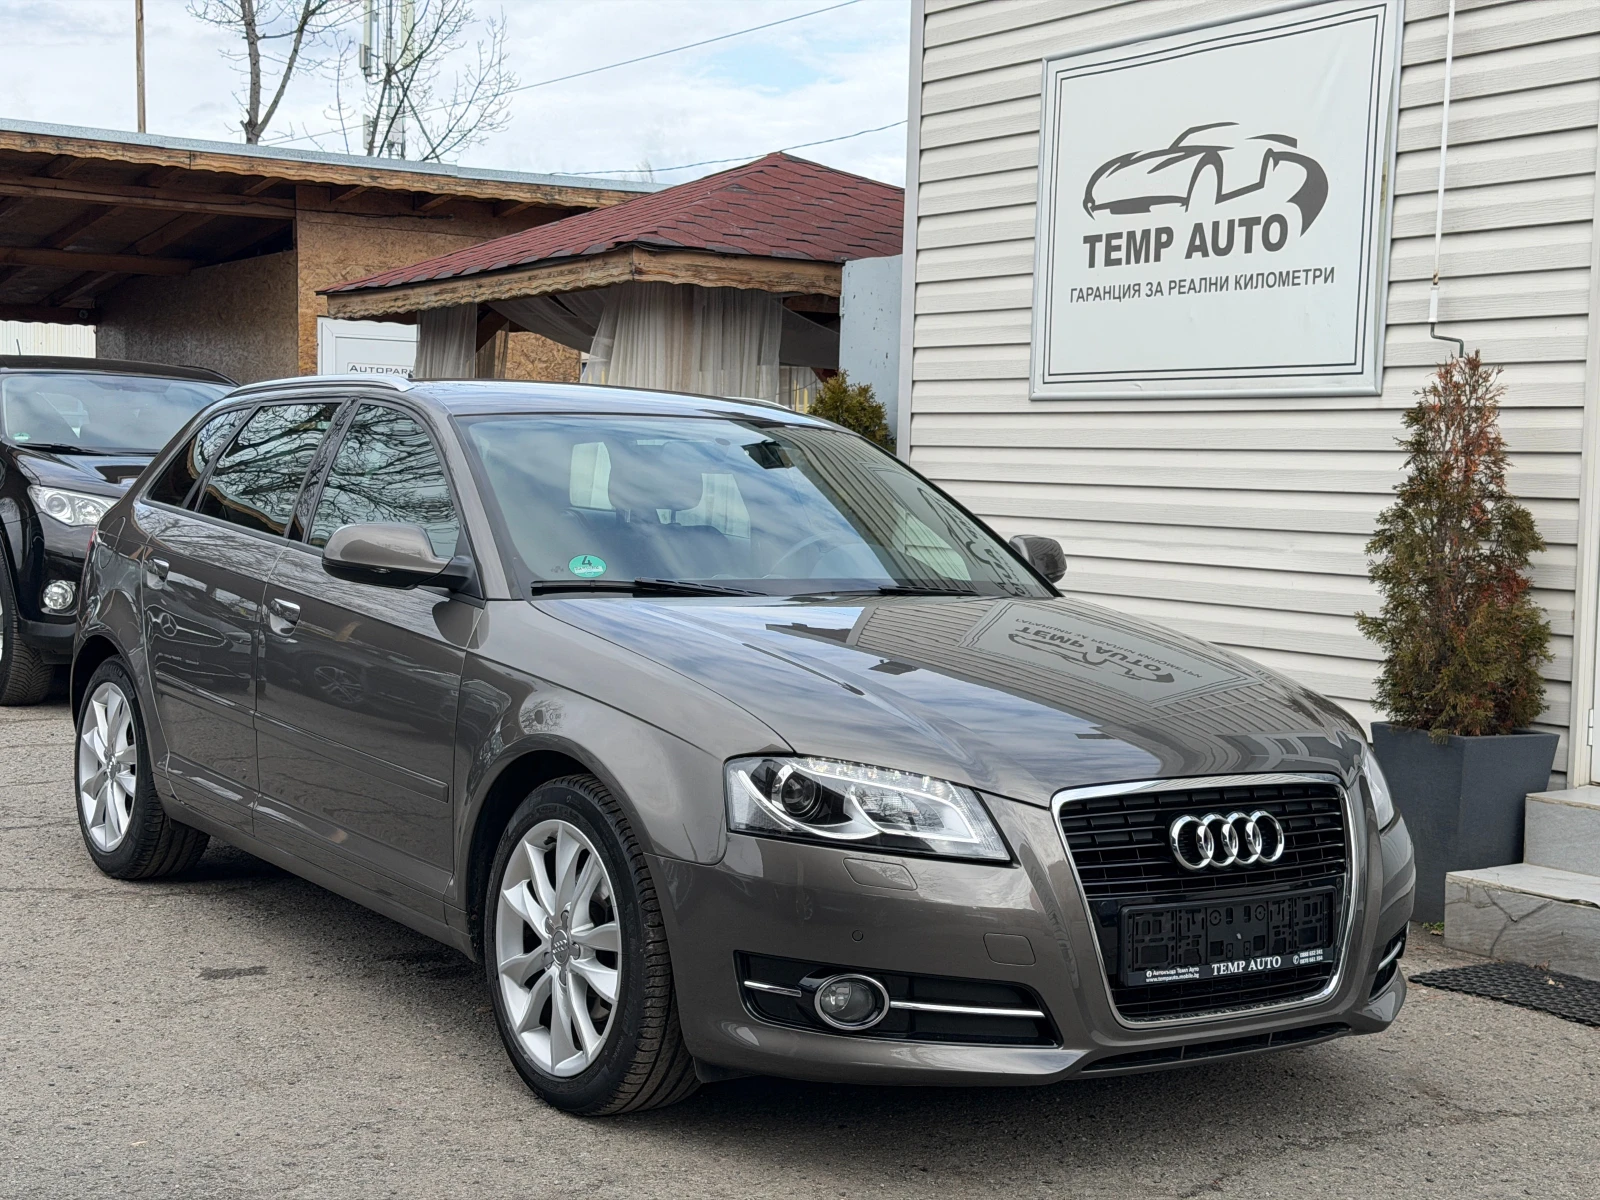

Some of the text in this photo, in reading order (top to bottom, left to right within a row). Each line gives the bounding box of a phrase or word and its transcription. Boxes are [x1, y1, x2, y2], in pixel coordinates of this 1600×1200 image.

[1083, 213, 1288, 268] TEMP AUTO
[1070, 266, 1335, 303] ГАРАНЦИЯ ЗА РЕАЛНИ КИЛОМЕТРИ
[581, 555, 592, 566] 4
[1212, 960, 1246, 976] TEMP
[1248, 955, 1281, 971] AUTO
